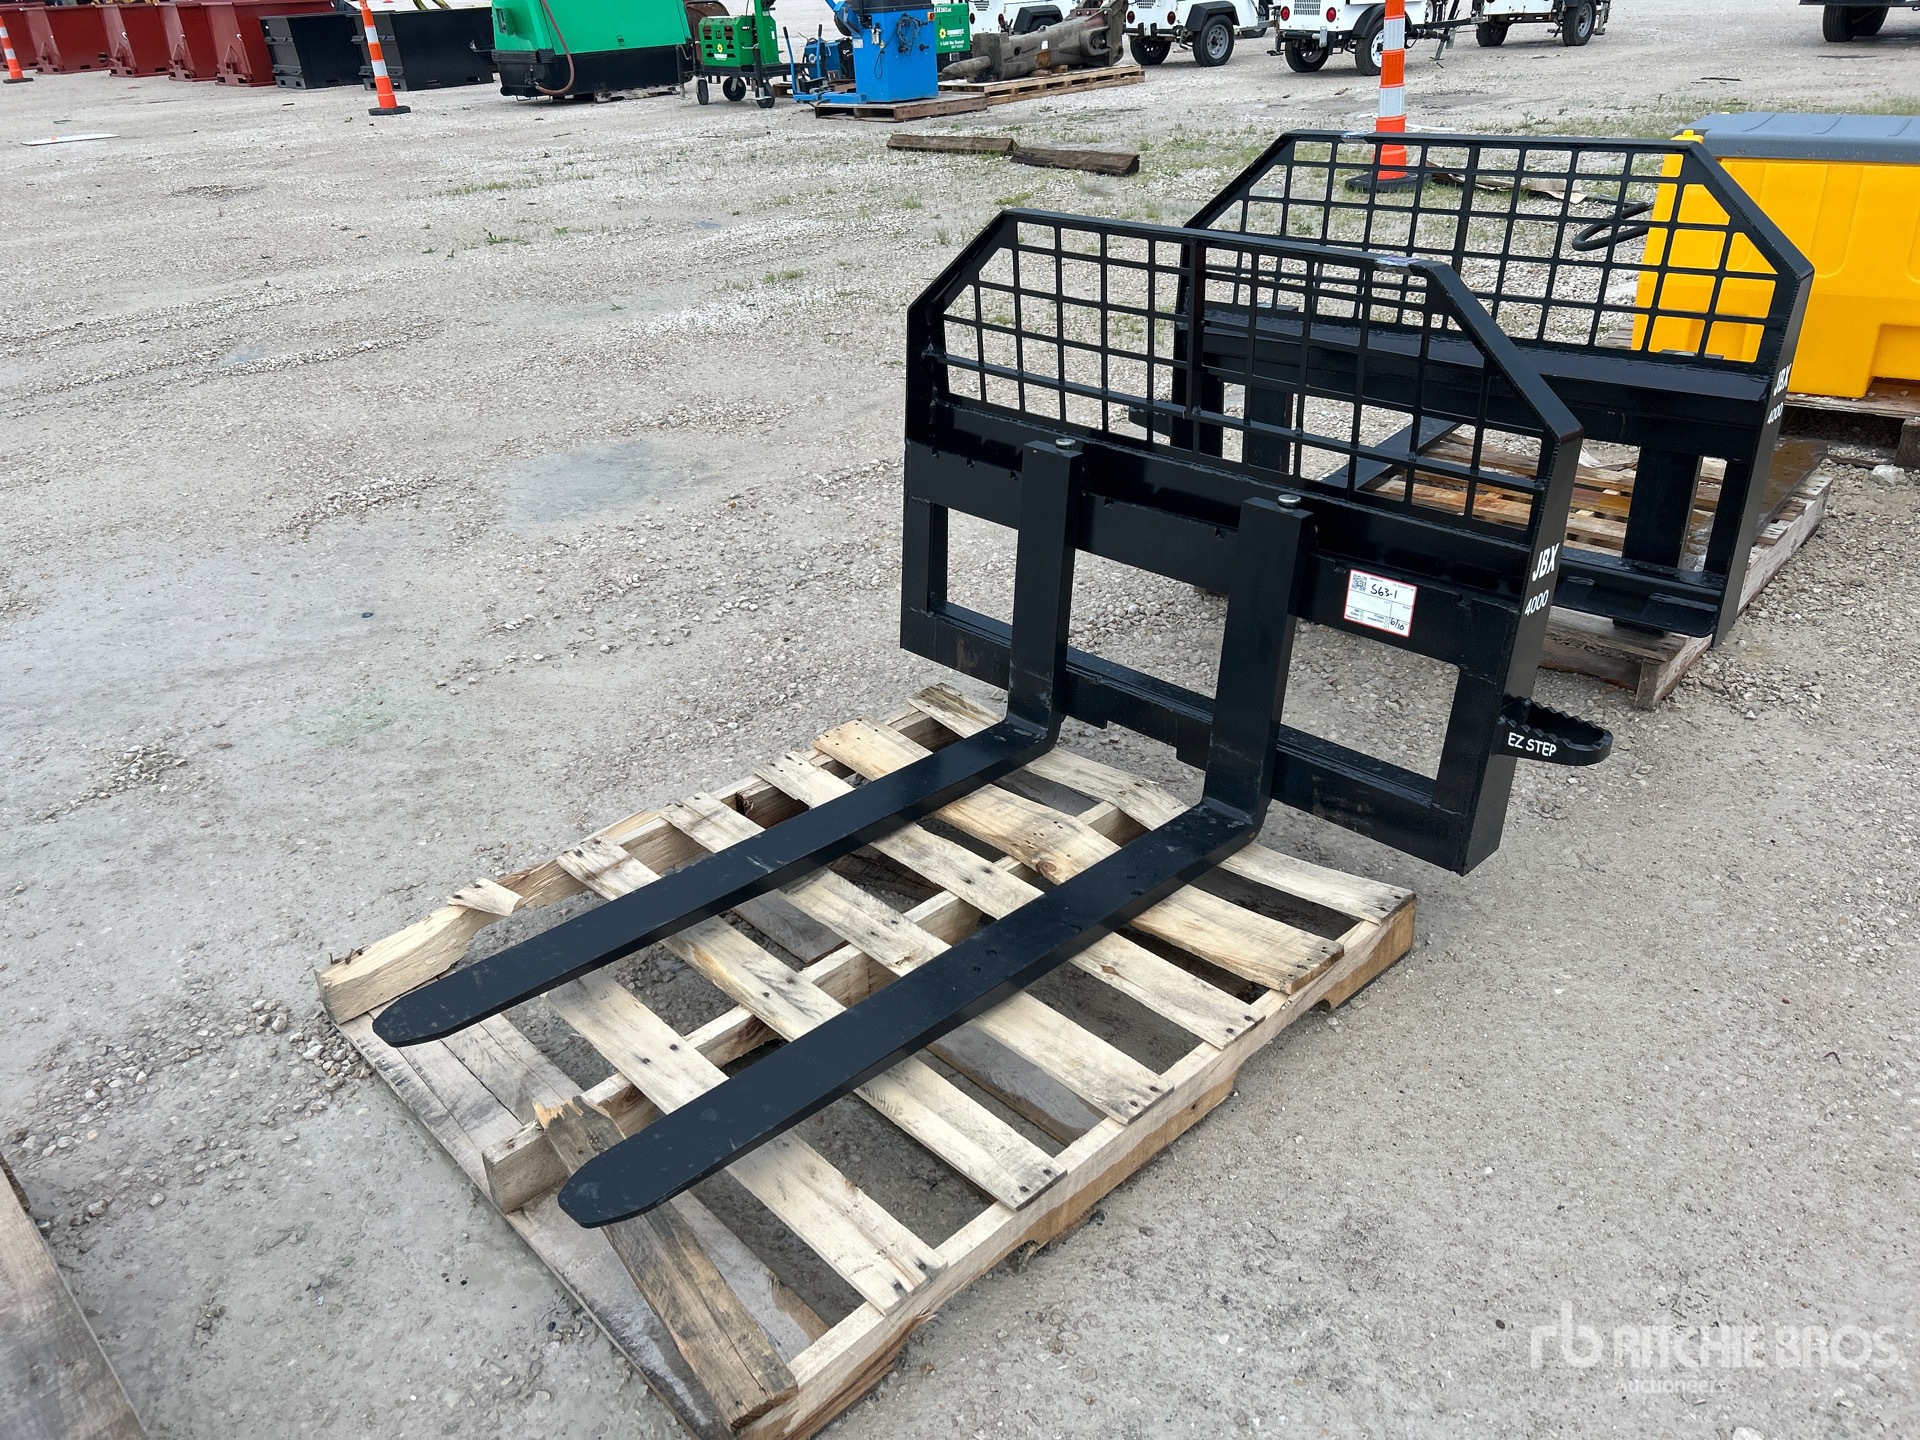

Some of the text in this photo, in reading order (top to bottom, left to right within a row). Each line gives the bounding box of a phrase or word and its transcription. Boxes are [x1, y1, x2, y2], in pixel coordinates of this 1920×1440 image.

[1773, 363, 1792, 397] JBX
[1767, 401, 1784, 425] 4000
[1532, 542, 1560, 582] JBX
[1524, 589, 1549, 616] 4000
[1507, 731, 1557, 757] EZ STEP
